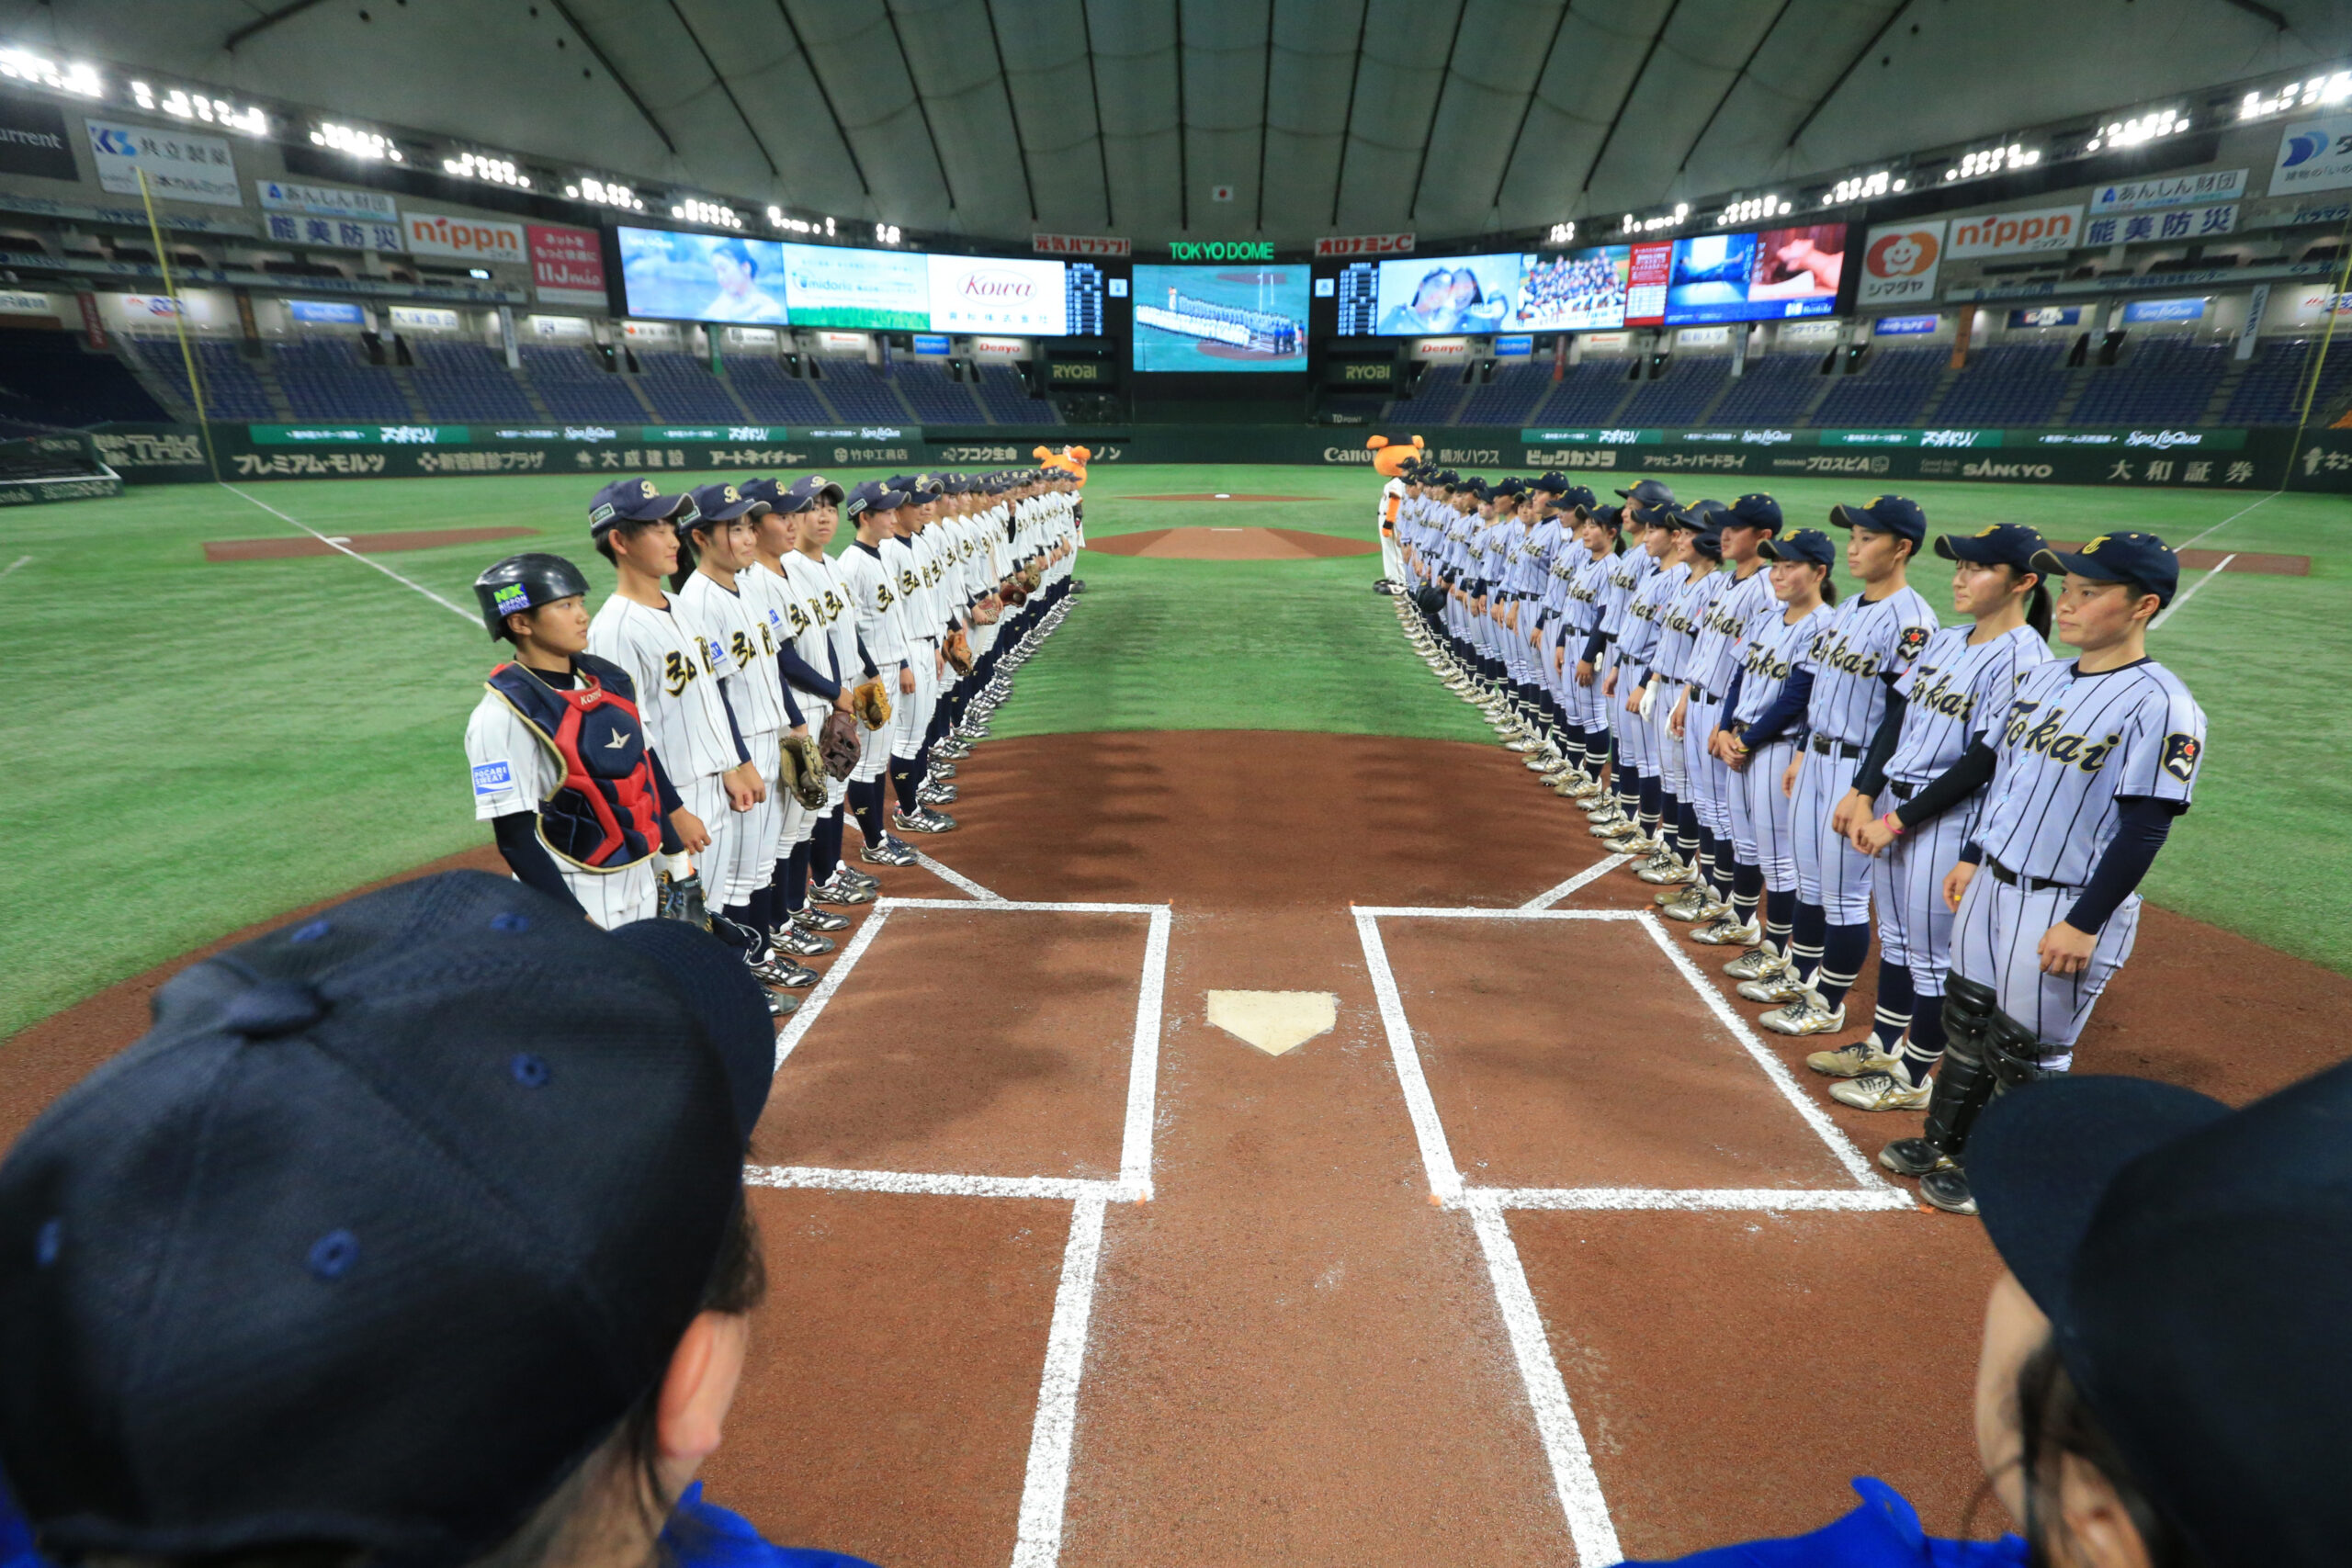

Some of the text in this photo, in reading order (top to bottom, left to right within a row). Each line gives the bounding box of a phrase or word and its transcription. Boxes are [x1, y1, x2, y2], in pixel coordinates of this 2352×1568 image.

[2119, 172, 2238, 200] あんしん財団
[269, 215, 398, 250] 能美防災
[1956, 214, 2072, 248] nippn
[2088, 205, 2234, 243] 能美防災
[413, 218, 517, 252] nippn
[1318, 234, 1412, 254] オロナミンC
[1035, 236, 1130, 254] 元気ハツラツ!
[1169, 242, 1275, 260] TOKYO DOME
[965, 275, 1032, 297] Kowa
[1868, 280, 1924, 297] シマダヤ
[1421, 344, 1464, 354] Denyo
[1052, 364, 1097, 378] RYOBI
[1345, 365, 1390, 379] RYOBI
[125, 434, 204, 459] THK
[851, 448, 909, 461] 竹中工務店
[958, 446, 1017, 461] フコク生命
[1440, 448, 1500, 464] 積水ハウス
[601, 449, 684, 468] 大成建設
[709, 448, 807, 465] アートネイチャー
[1526, 449, 1616, 468] ビックカメラ
[1806, 456, 1870, 471] プロスピA
[1962, 457, 2053, 478] SANKYO
[2107, 458, 2255, 483] 大和証券
[2006, 700, 2121, 773] Tokai
[474, 766, 507, 777] POCARI
